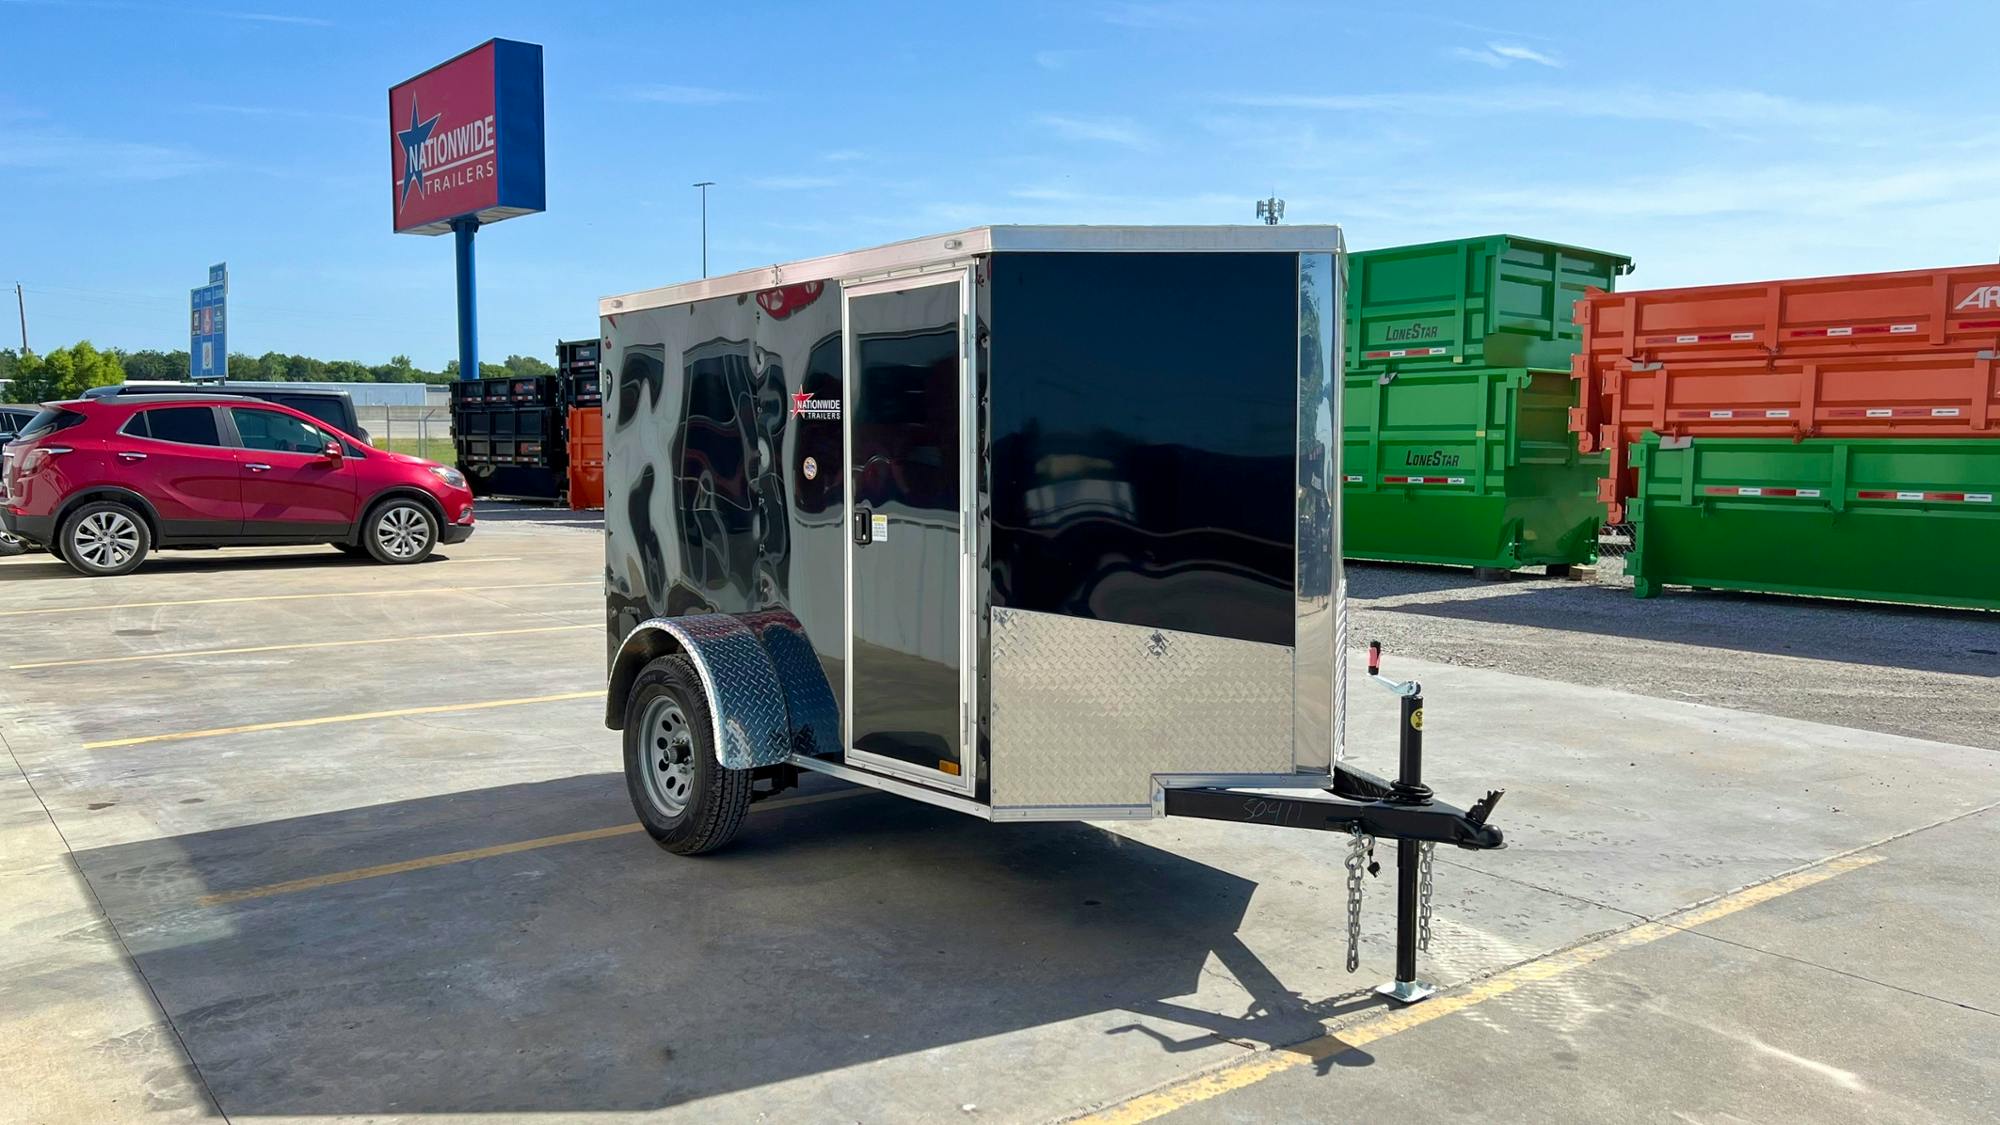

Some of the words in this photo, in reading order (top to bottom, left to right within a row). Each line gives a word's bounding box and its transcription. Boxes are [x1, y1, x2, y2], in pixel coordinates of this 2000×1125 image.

[409, 115, 494, 173] NATIONWIDE
[425, 161, 494, 195] TRAILERS
[797, 399, 841, 409] NATIONWIDE
[808, 412, 841, 420] TRAILERS
